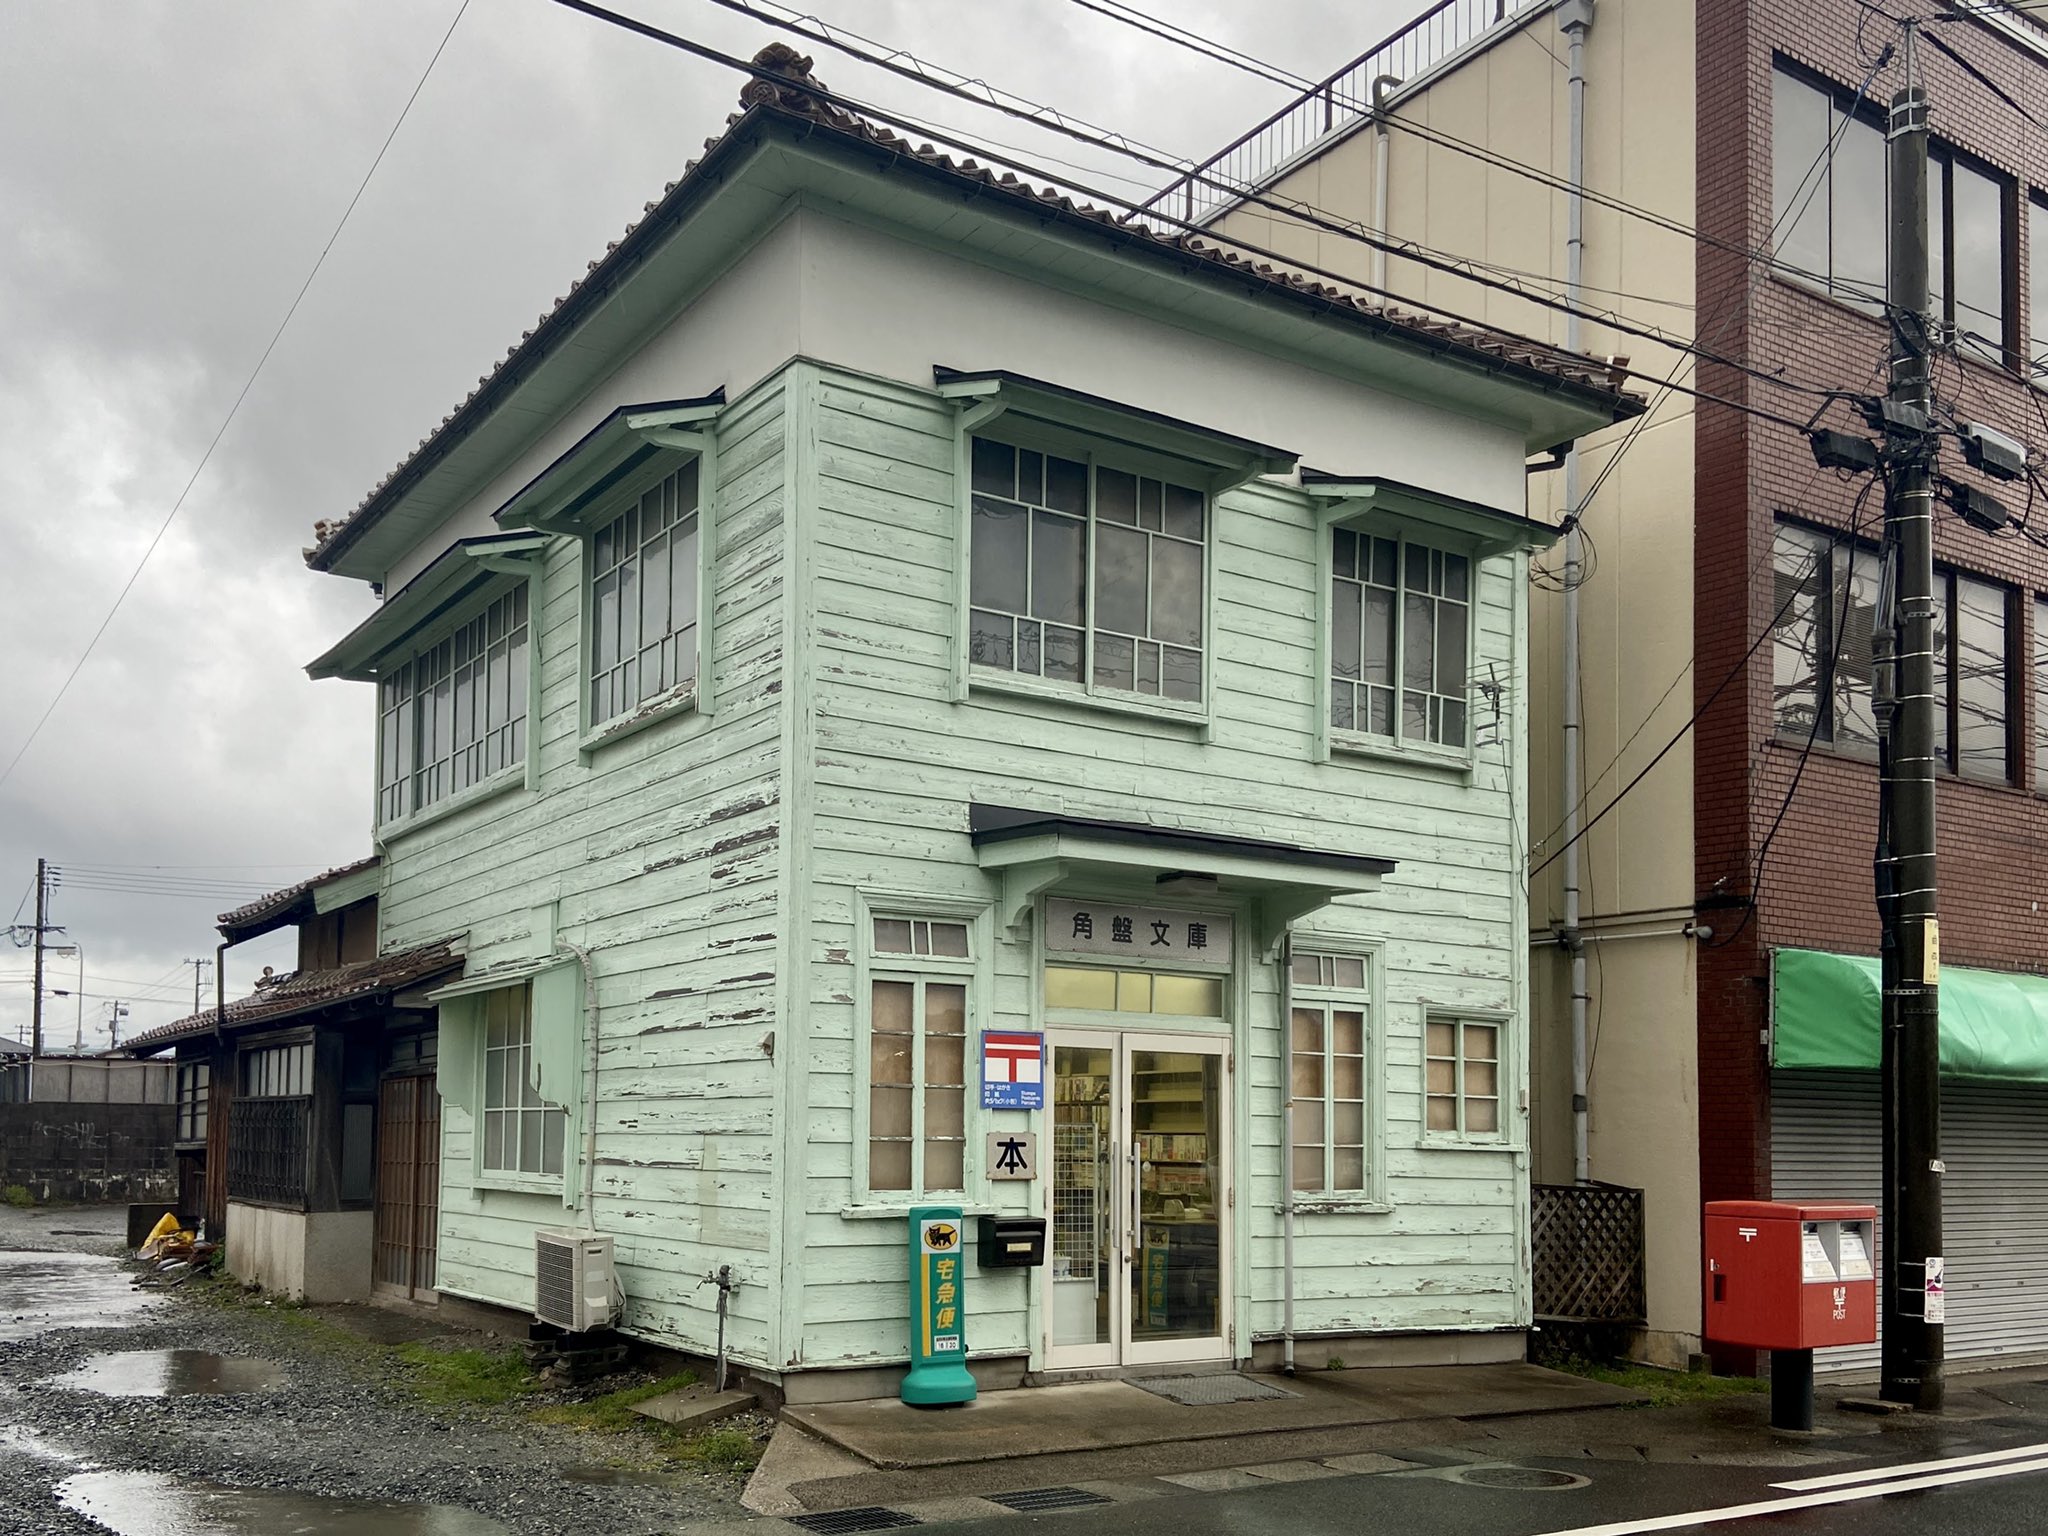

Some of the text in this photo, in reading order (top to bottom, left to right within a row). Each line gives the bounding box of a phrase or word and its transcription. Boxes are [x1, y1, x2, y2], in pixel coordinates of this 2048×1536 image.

[1072, 911, 1208, 950] 角盤文庫
[996, 1137, 1028, 1175] 本
[935, 1258, 956, 1330] 宅急便
[1833, 1309, 1846, 1320] POST
